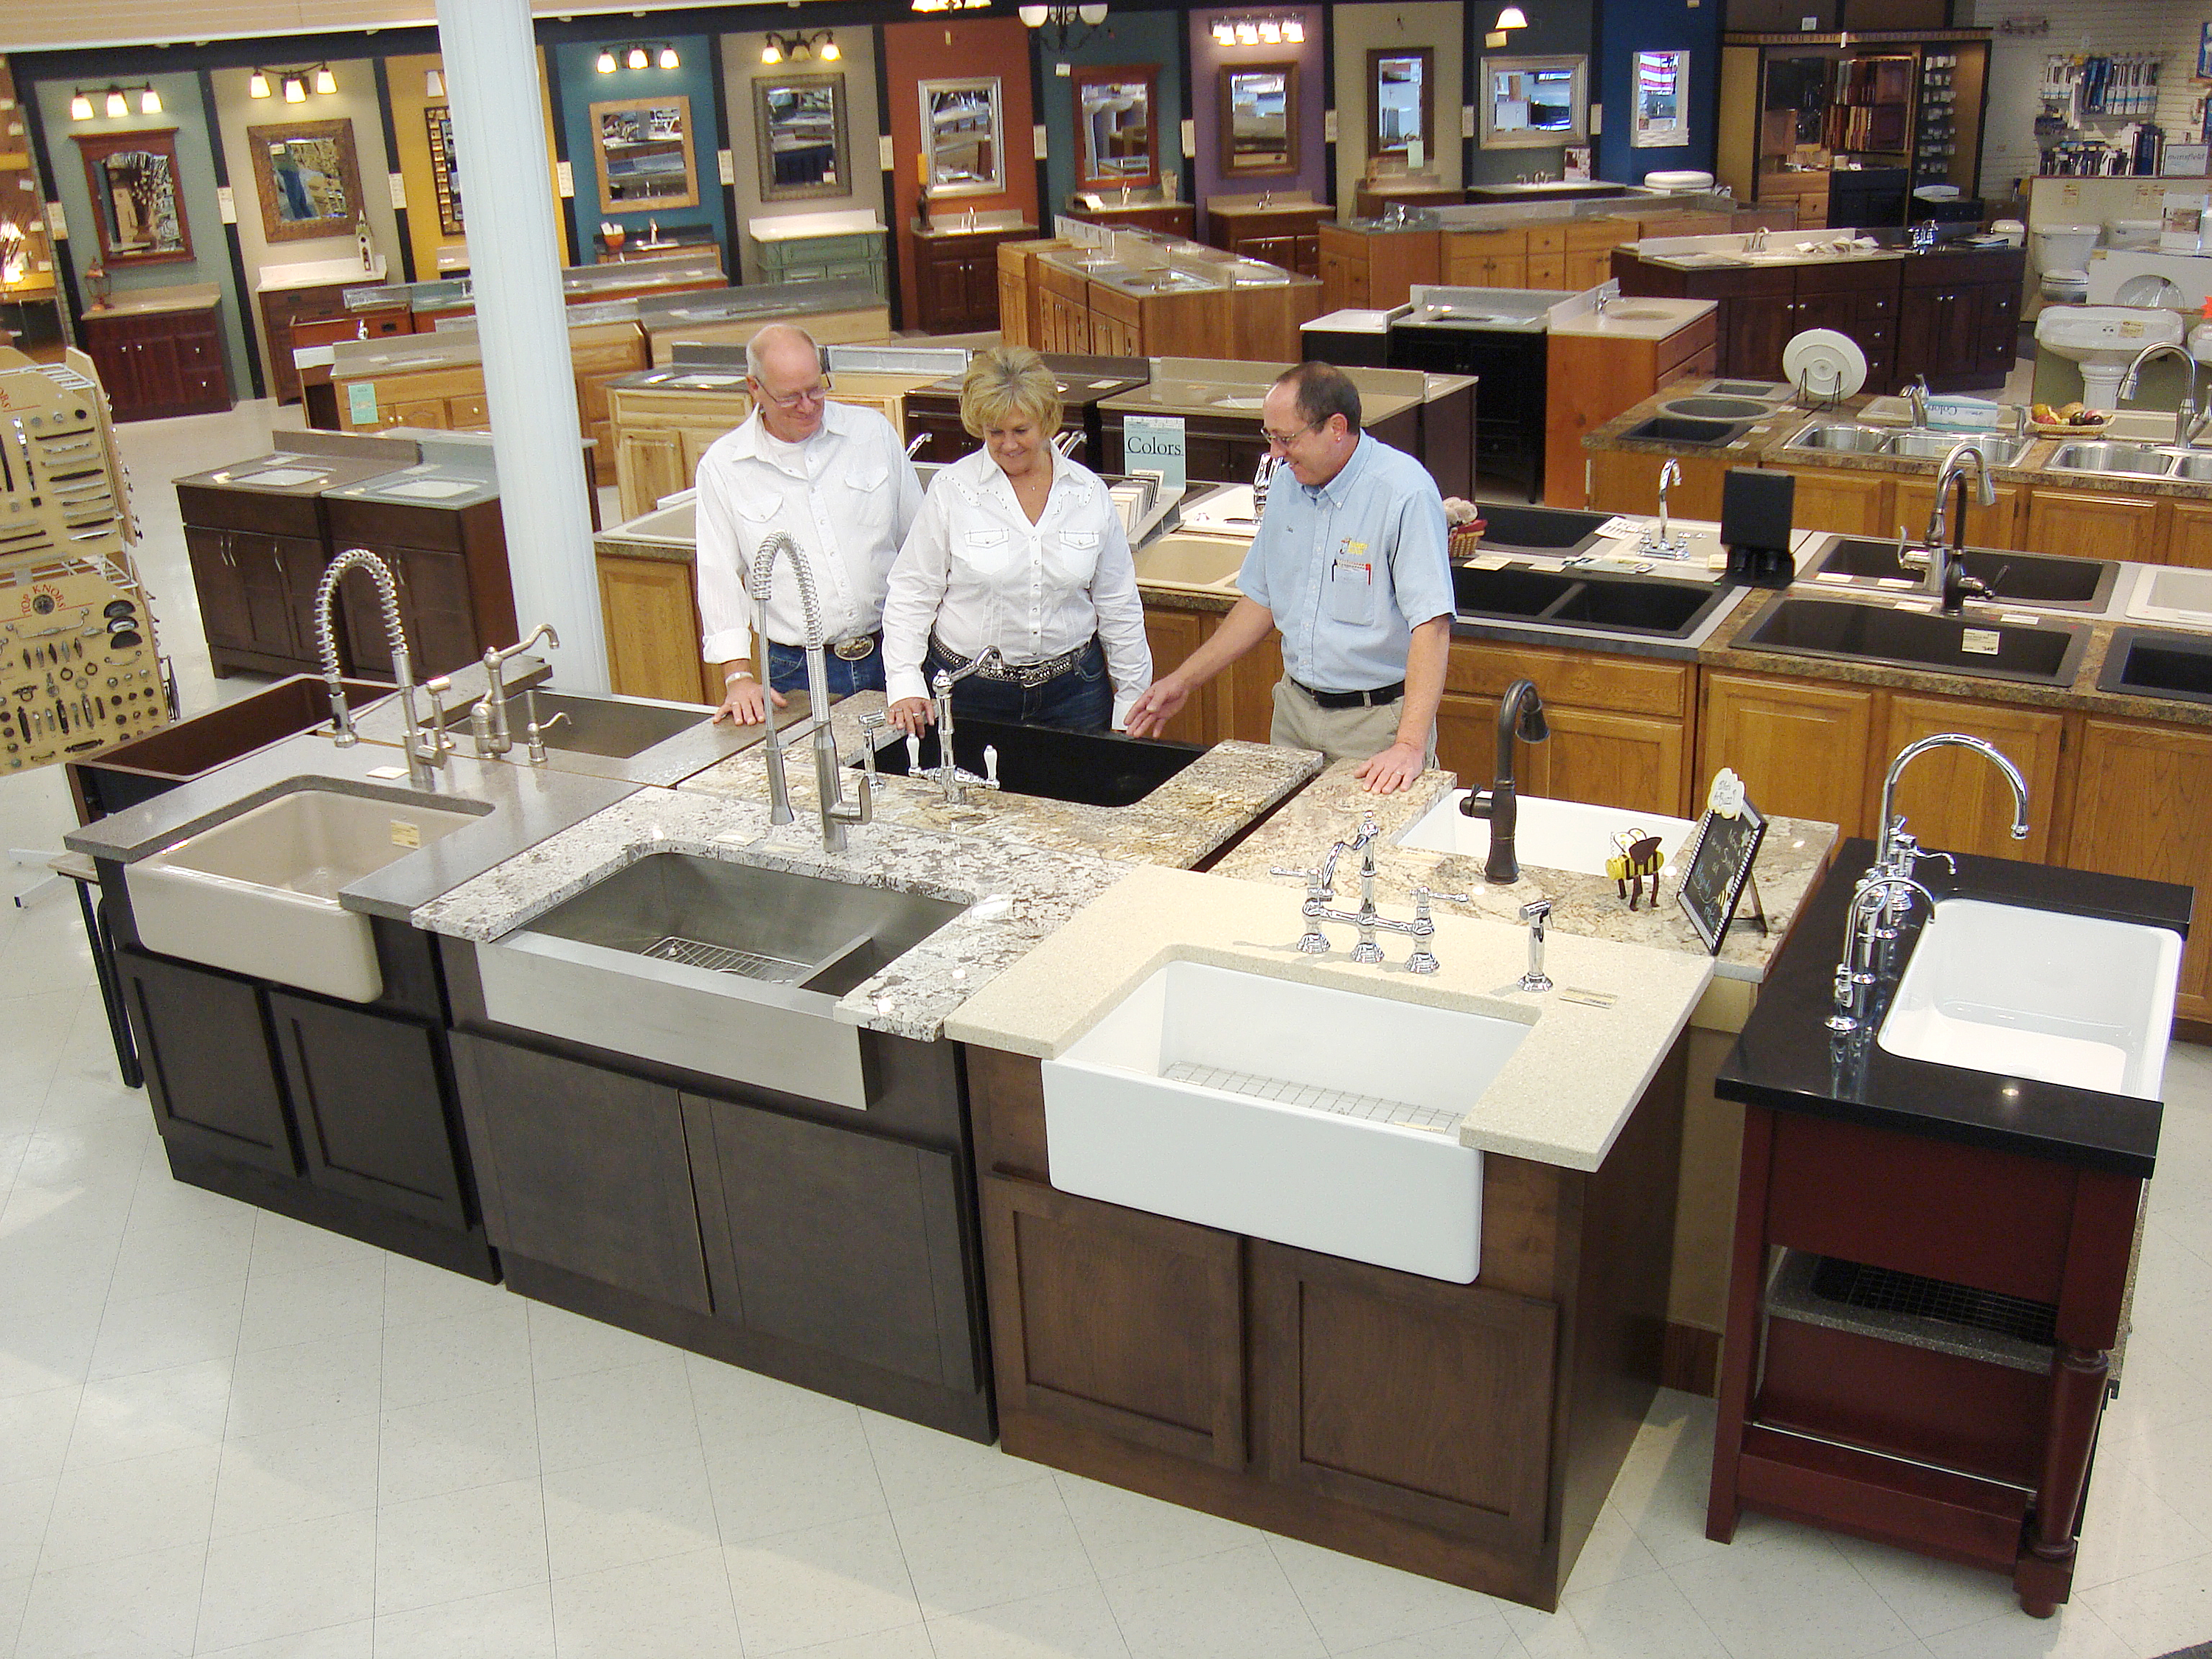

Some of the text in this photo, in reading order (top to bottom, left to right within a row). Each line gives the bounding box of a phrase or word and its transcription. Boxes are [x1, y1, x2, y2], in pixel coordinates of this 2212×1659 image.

[1127, 436, 1181, 455] Colors
[21, 584, 66, 616] TOP KNOBS
